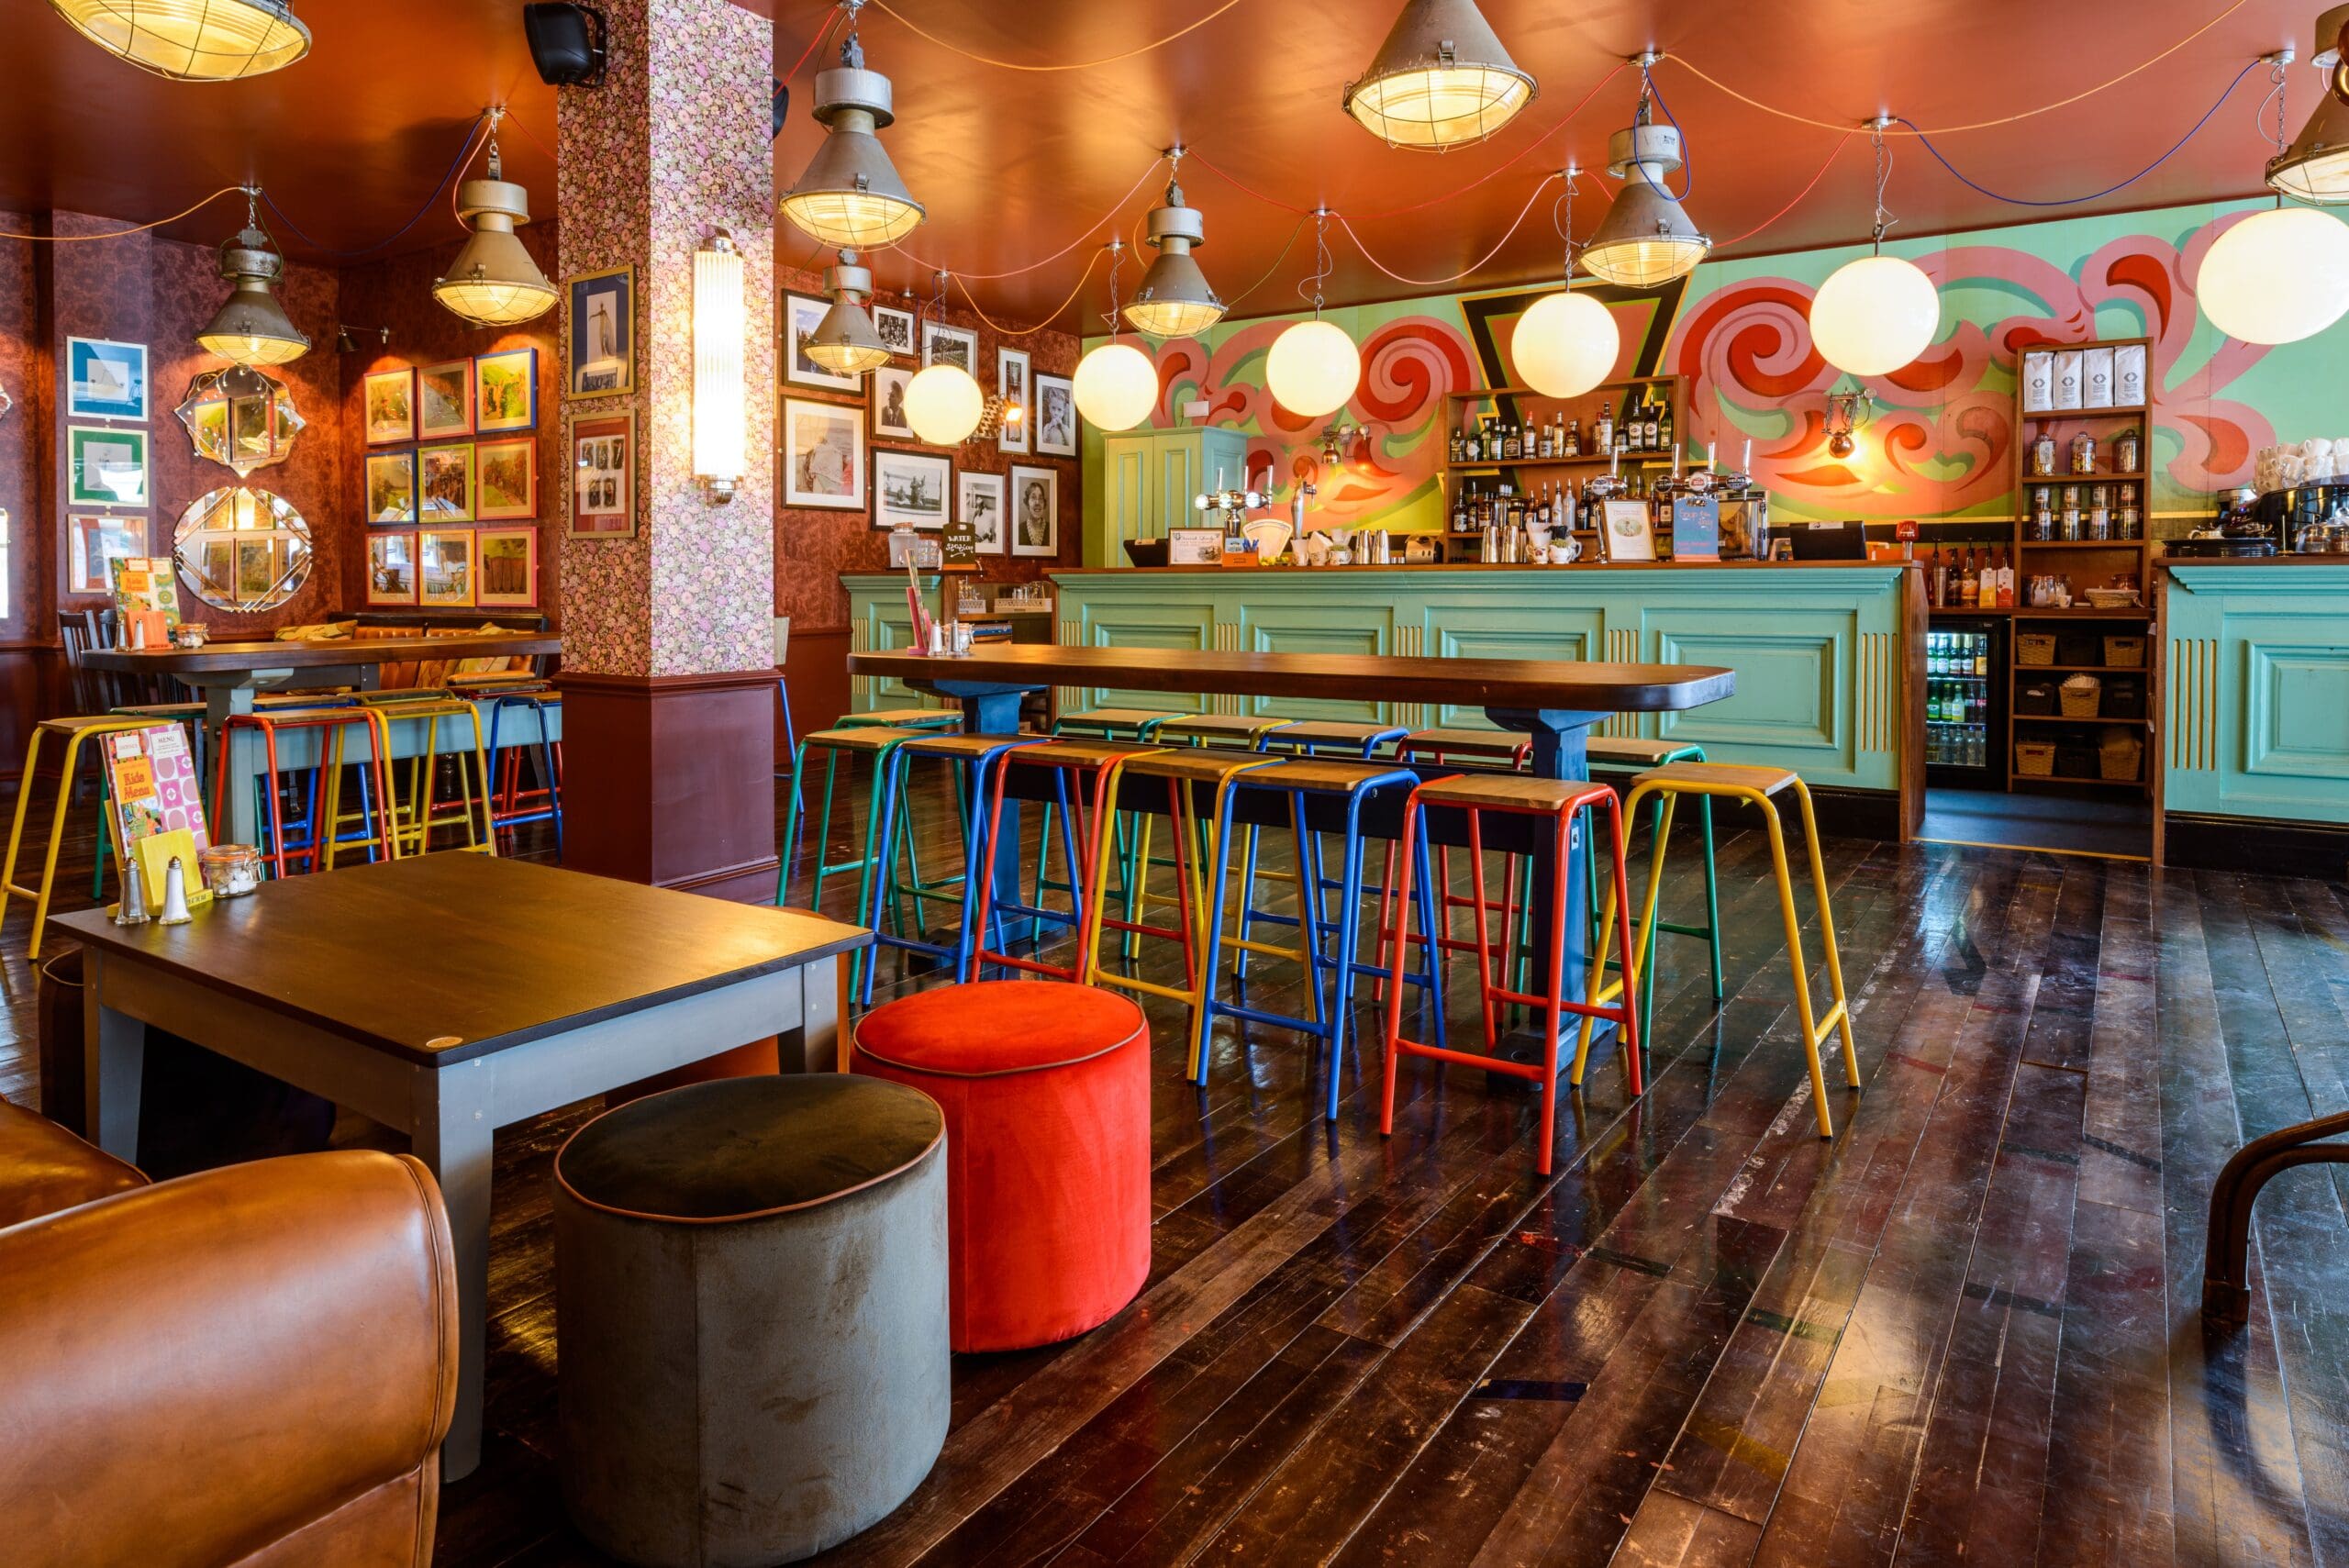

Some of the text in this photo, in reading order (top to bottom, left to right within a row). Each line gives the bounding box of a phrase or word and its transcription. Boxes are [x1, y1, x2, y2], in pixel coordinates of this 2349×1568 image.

[158, 735, 175, 743] MENU
[123, 772, 146, 786] Kids
[124, 786, 151, 801] Menu
